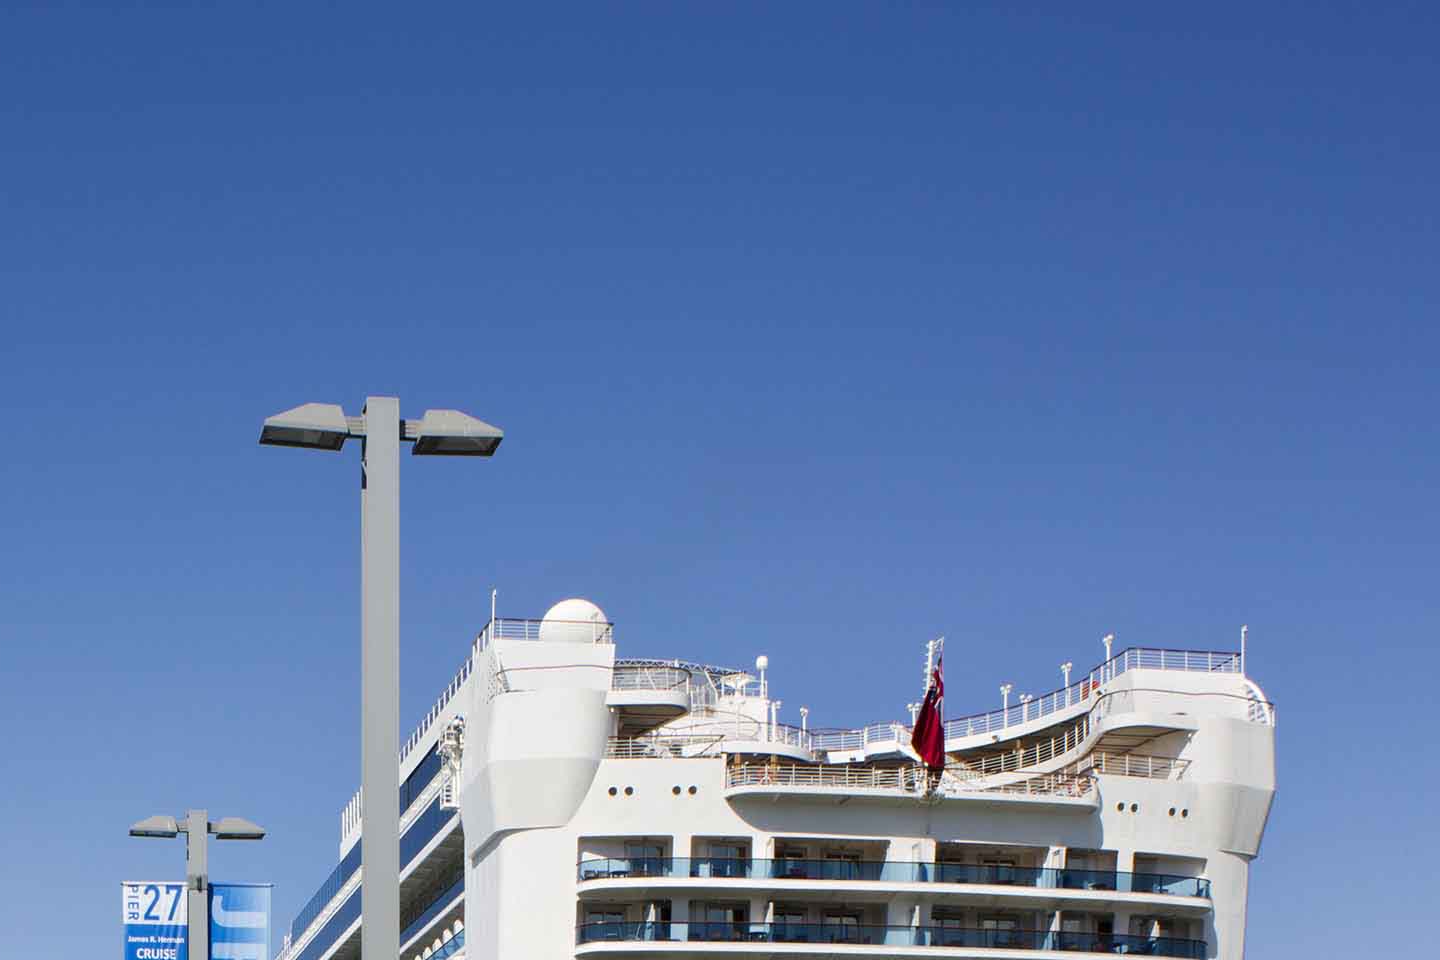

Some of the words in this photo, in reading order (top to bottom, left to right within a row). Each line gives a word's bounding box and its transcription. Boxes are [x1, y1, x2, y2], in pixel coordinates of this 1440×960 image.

[127, 884, 140, 921] PIER
[143, 884, 184, 921] 27
[136, 948, 177, 960] CRUISE
